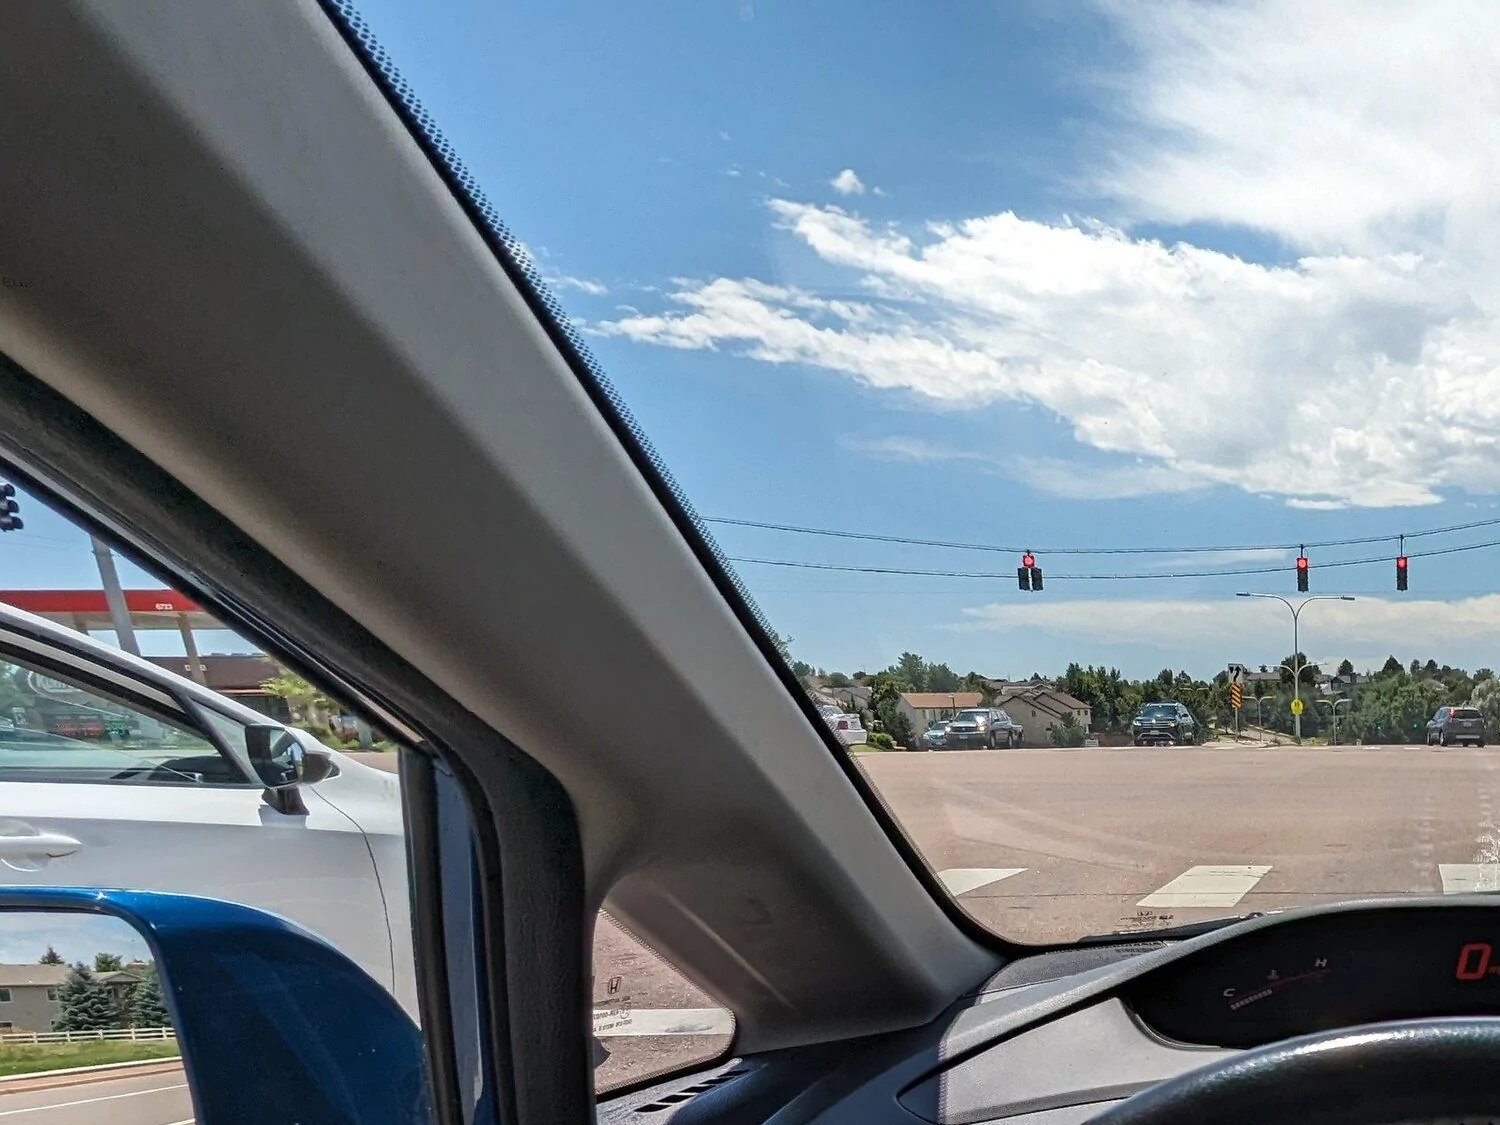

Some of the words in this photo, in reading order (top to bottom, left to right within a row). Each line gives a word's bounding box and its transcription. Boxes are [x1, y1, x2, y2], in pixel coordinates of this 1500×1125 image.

[1314, 957, 1328, 968] H
[1455, 943, 1492, 980] 0
[1223, 987, 1235, 997] C
